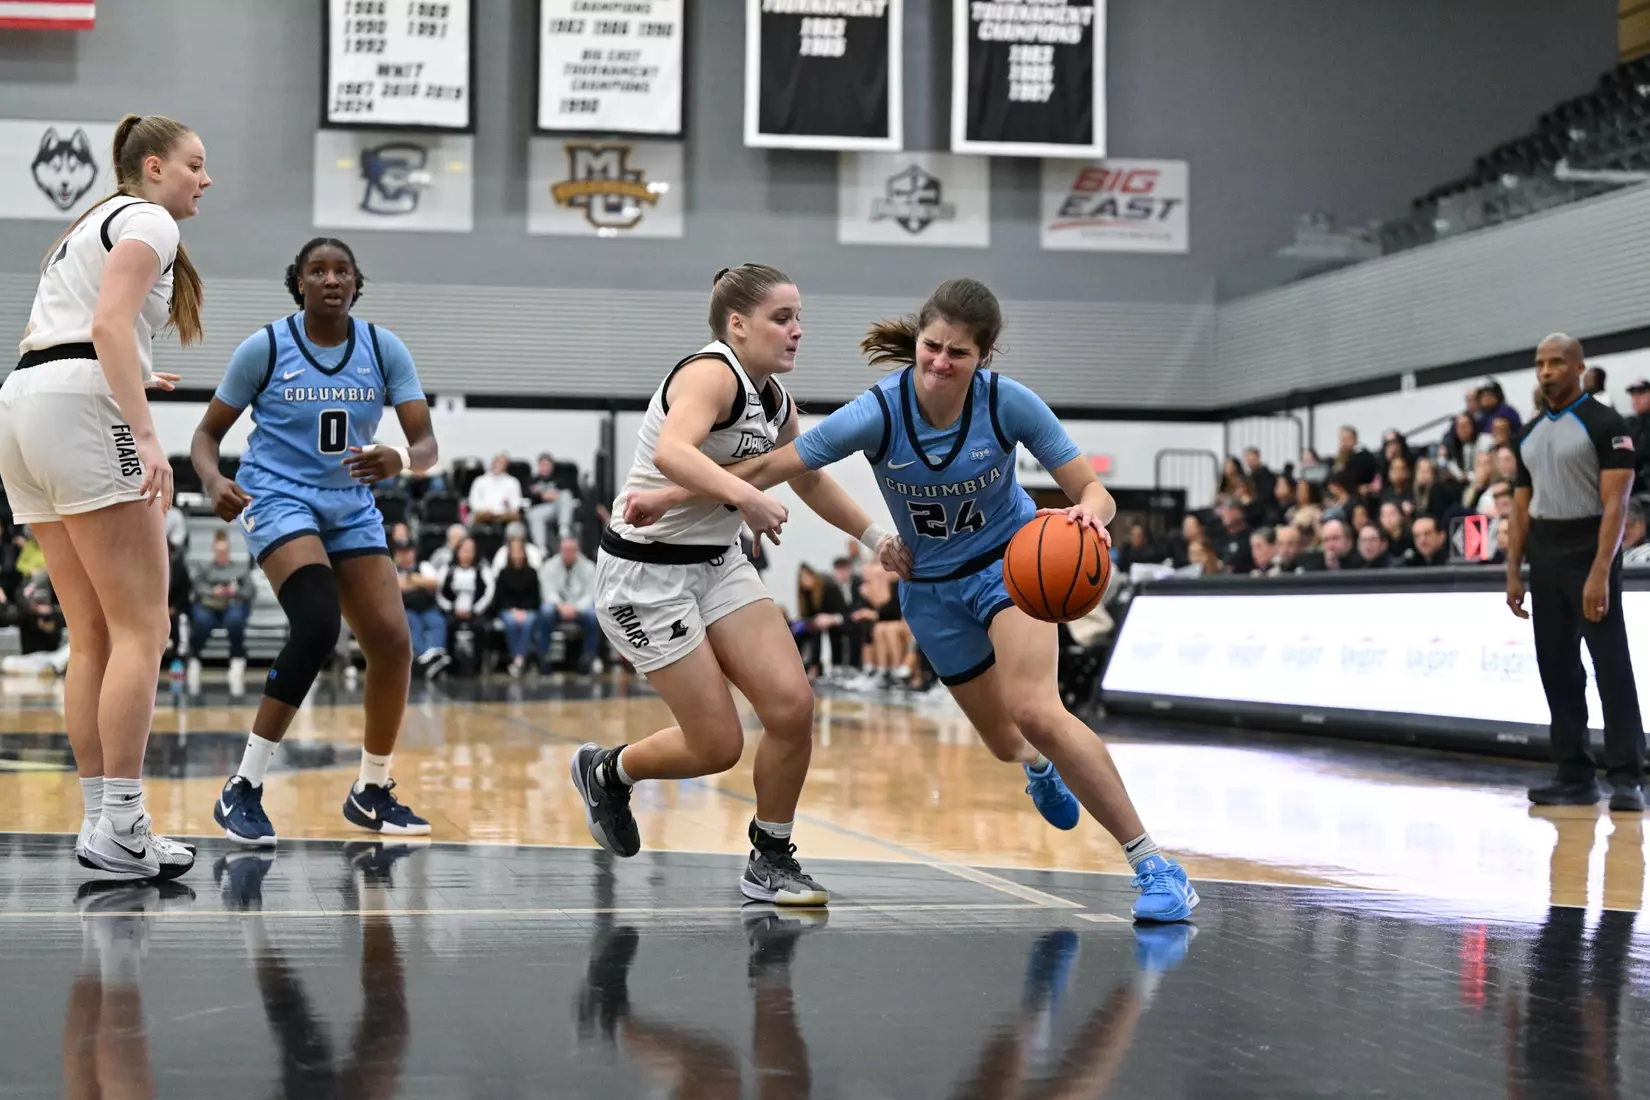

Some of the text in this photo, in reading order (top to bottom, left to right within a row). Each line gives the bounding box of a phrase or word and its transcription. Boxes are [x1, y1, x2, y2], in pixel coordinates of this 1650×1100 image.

[1072, 166, 1161, 194] BIG
[1058, 195, 1182, 221] EAST
[283, 386, 376, 401] COLUMBIA
[318, 408, 349, 455] 0
[111, 424, 142, 477] FRIARS
[885, 466, 1001, 498] COLUMBIA
[906, 498, 987, 541] 24
